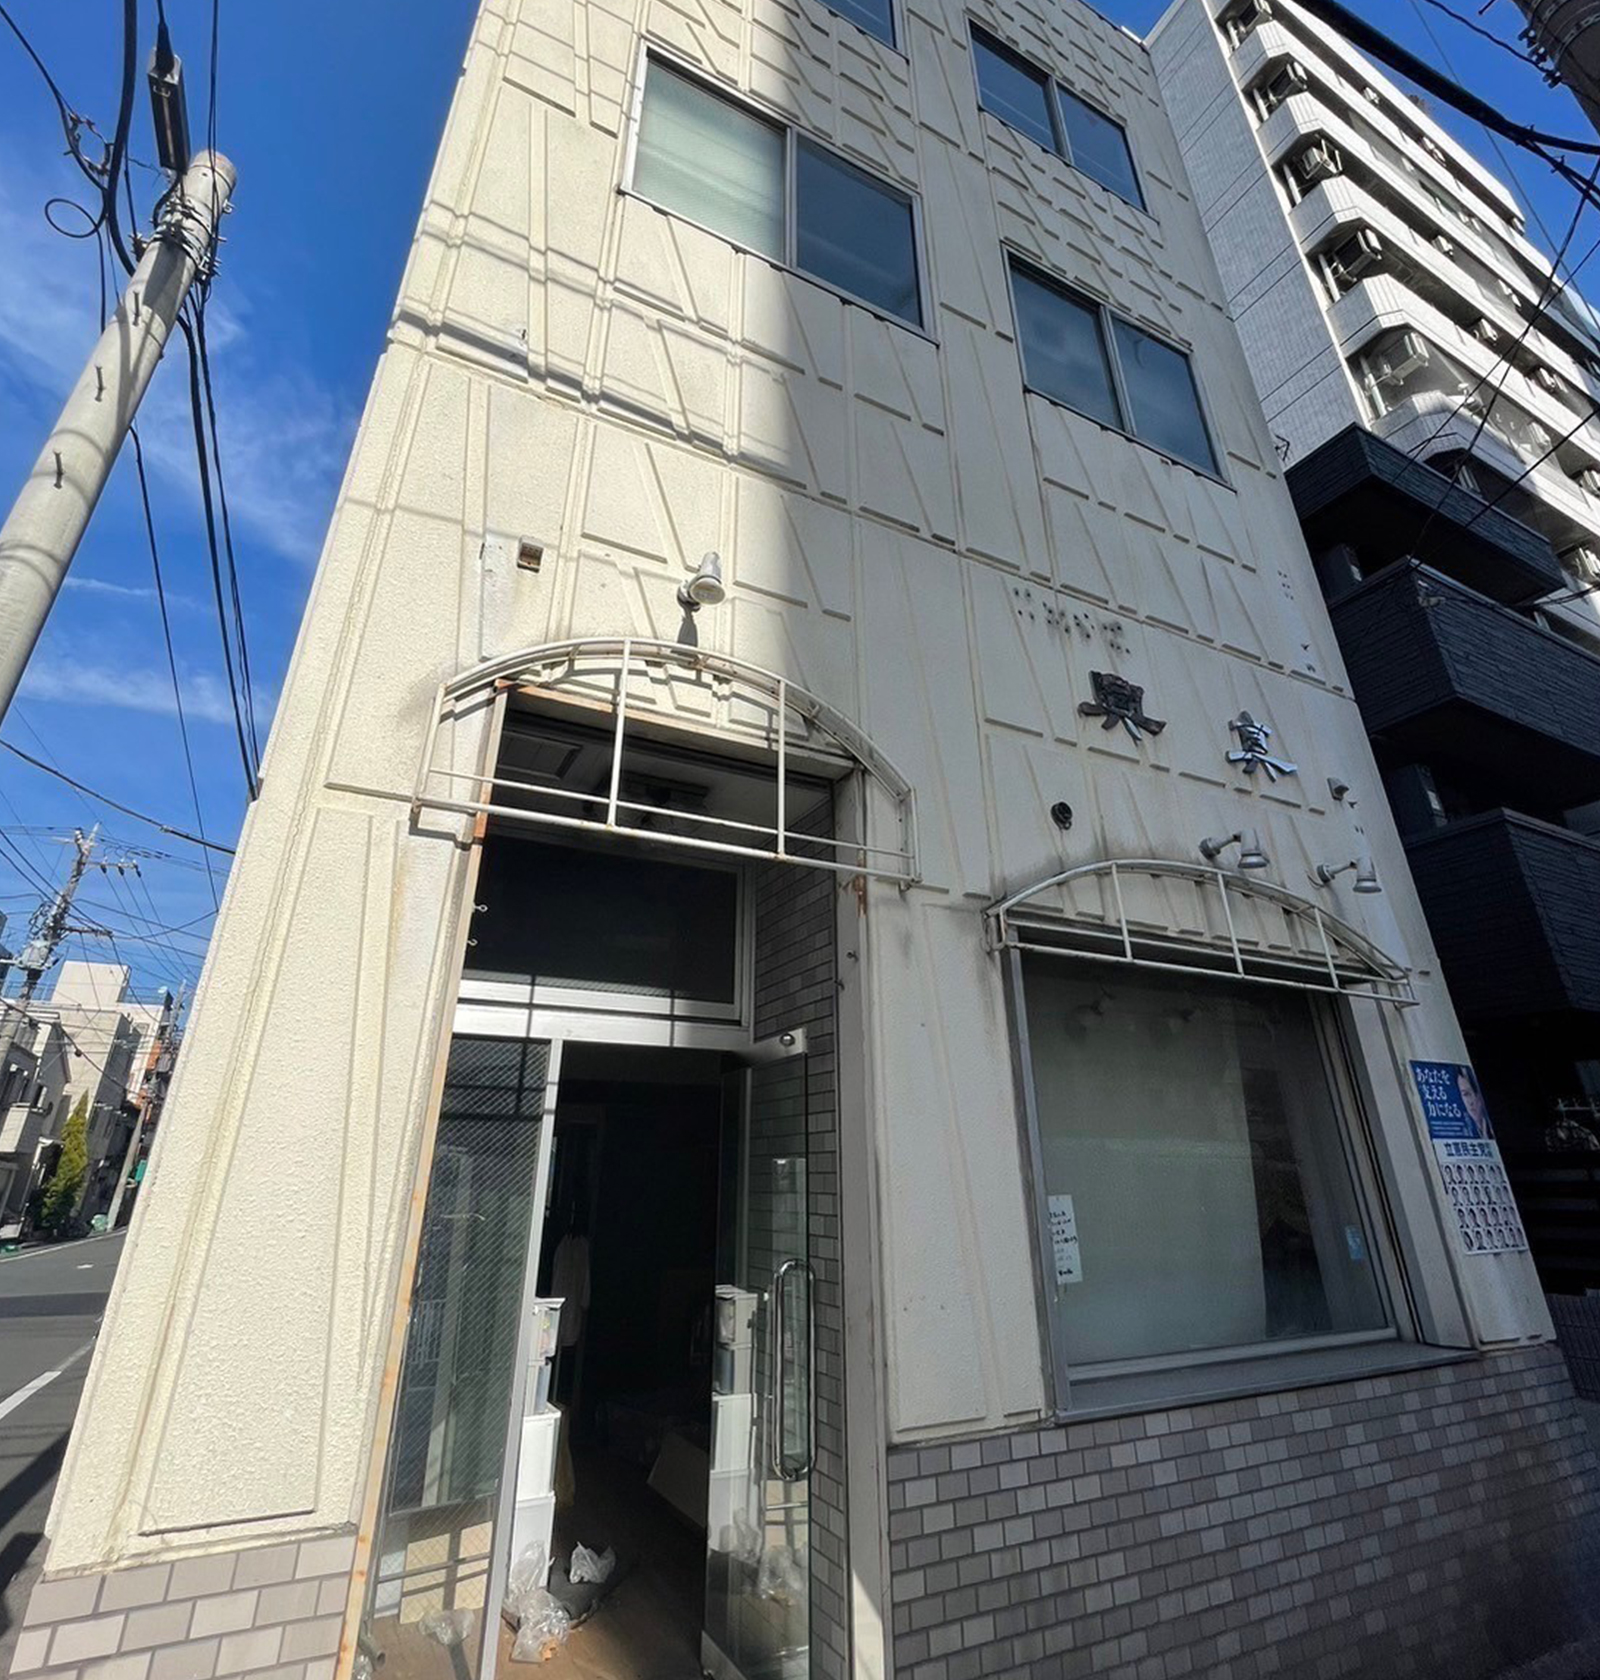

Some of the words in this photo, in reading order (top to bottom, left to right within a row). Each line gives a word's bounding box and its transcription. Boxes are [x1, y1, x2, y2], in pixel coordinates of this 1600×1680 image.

[1416, 1067, 1451, 1085] あなたを
[1428, 1102, 1461, 1117] 力になる
[1444, 1141, 1487, 1157] 立憲民主党
